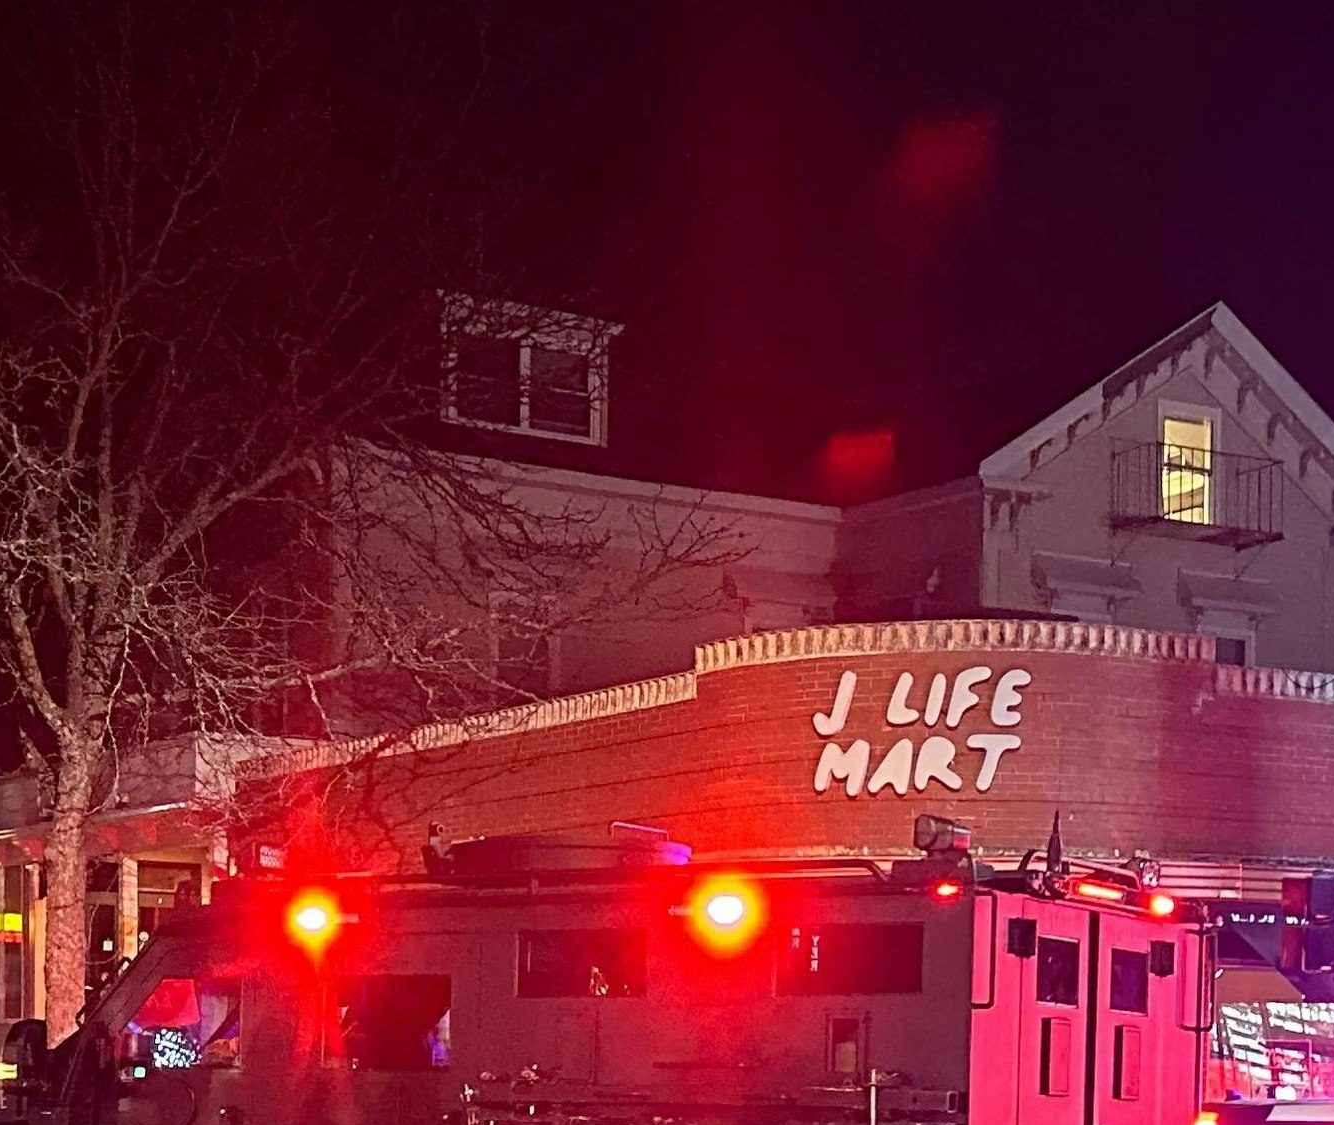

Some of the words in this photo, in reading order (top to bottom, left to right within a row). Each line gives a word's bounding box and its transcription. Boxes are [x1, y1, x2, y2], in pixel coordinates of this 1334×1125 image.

[813, 670, 858, 736] J
[886, 666, 1032, 728] LIFE
[814, 733, 1023, 797] MART
